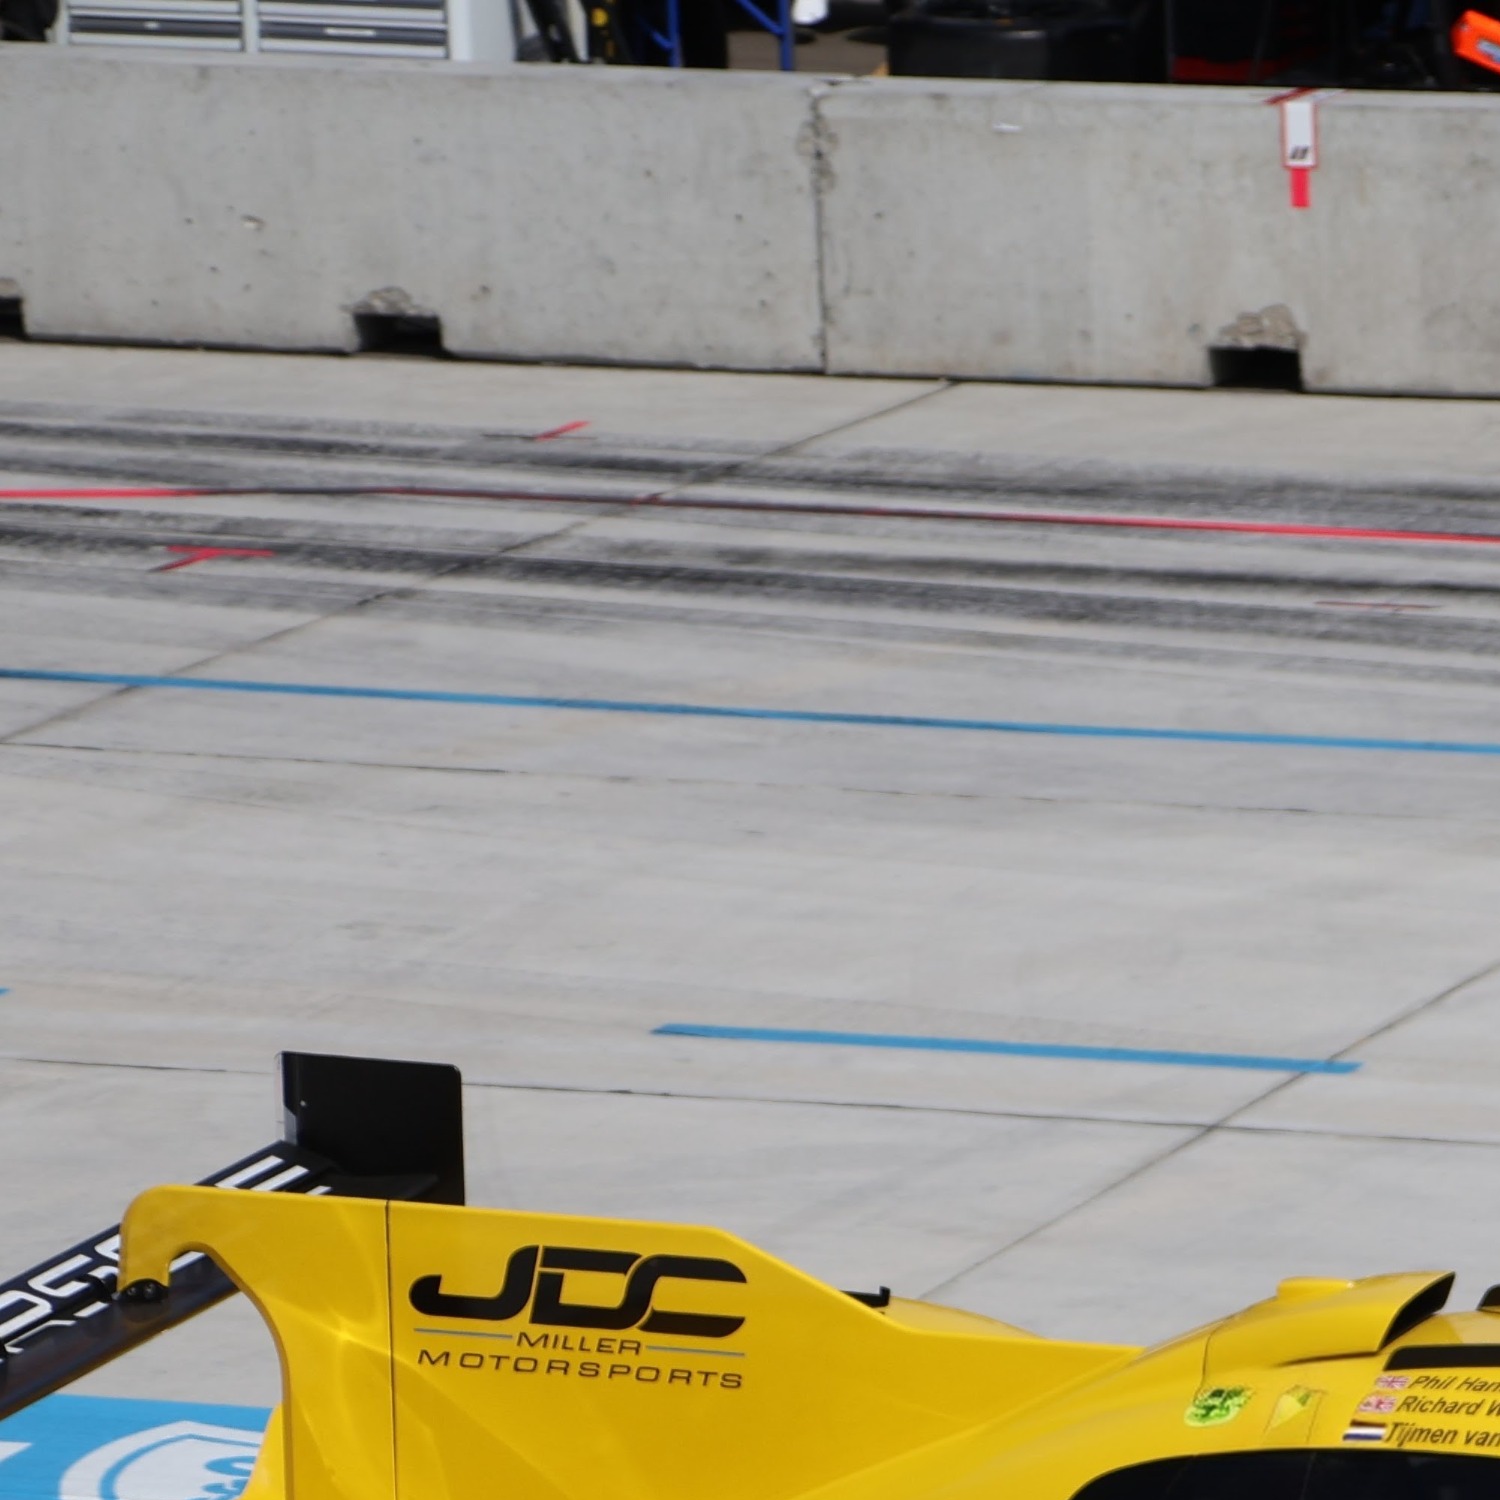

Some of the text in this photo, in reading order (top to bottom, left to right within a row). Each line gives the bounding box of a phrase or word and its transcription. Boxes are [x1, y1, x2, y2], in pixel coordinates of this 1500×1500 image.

[409, 1245, 747, 1338] JDC
[517, 1332, 642, 1355] MILLER
[418, 1350, 742, 1388] MOTORSPORTS
[1408, 1376, 1456, 1391] Phil
[1396, 1396, 1484, 1416] Richard
[1385, 1423, 1458, 1447] Tijmen
